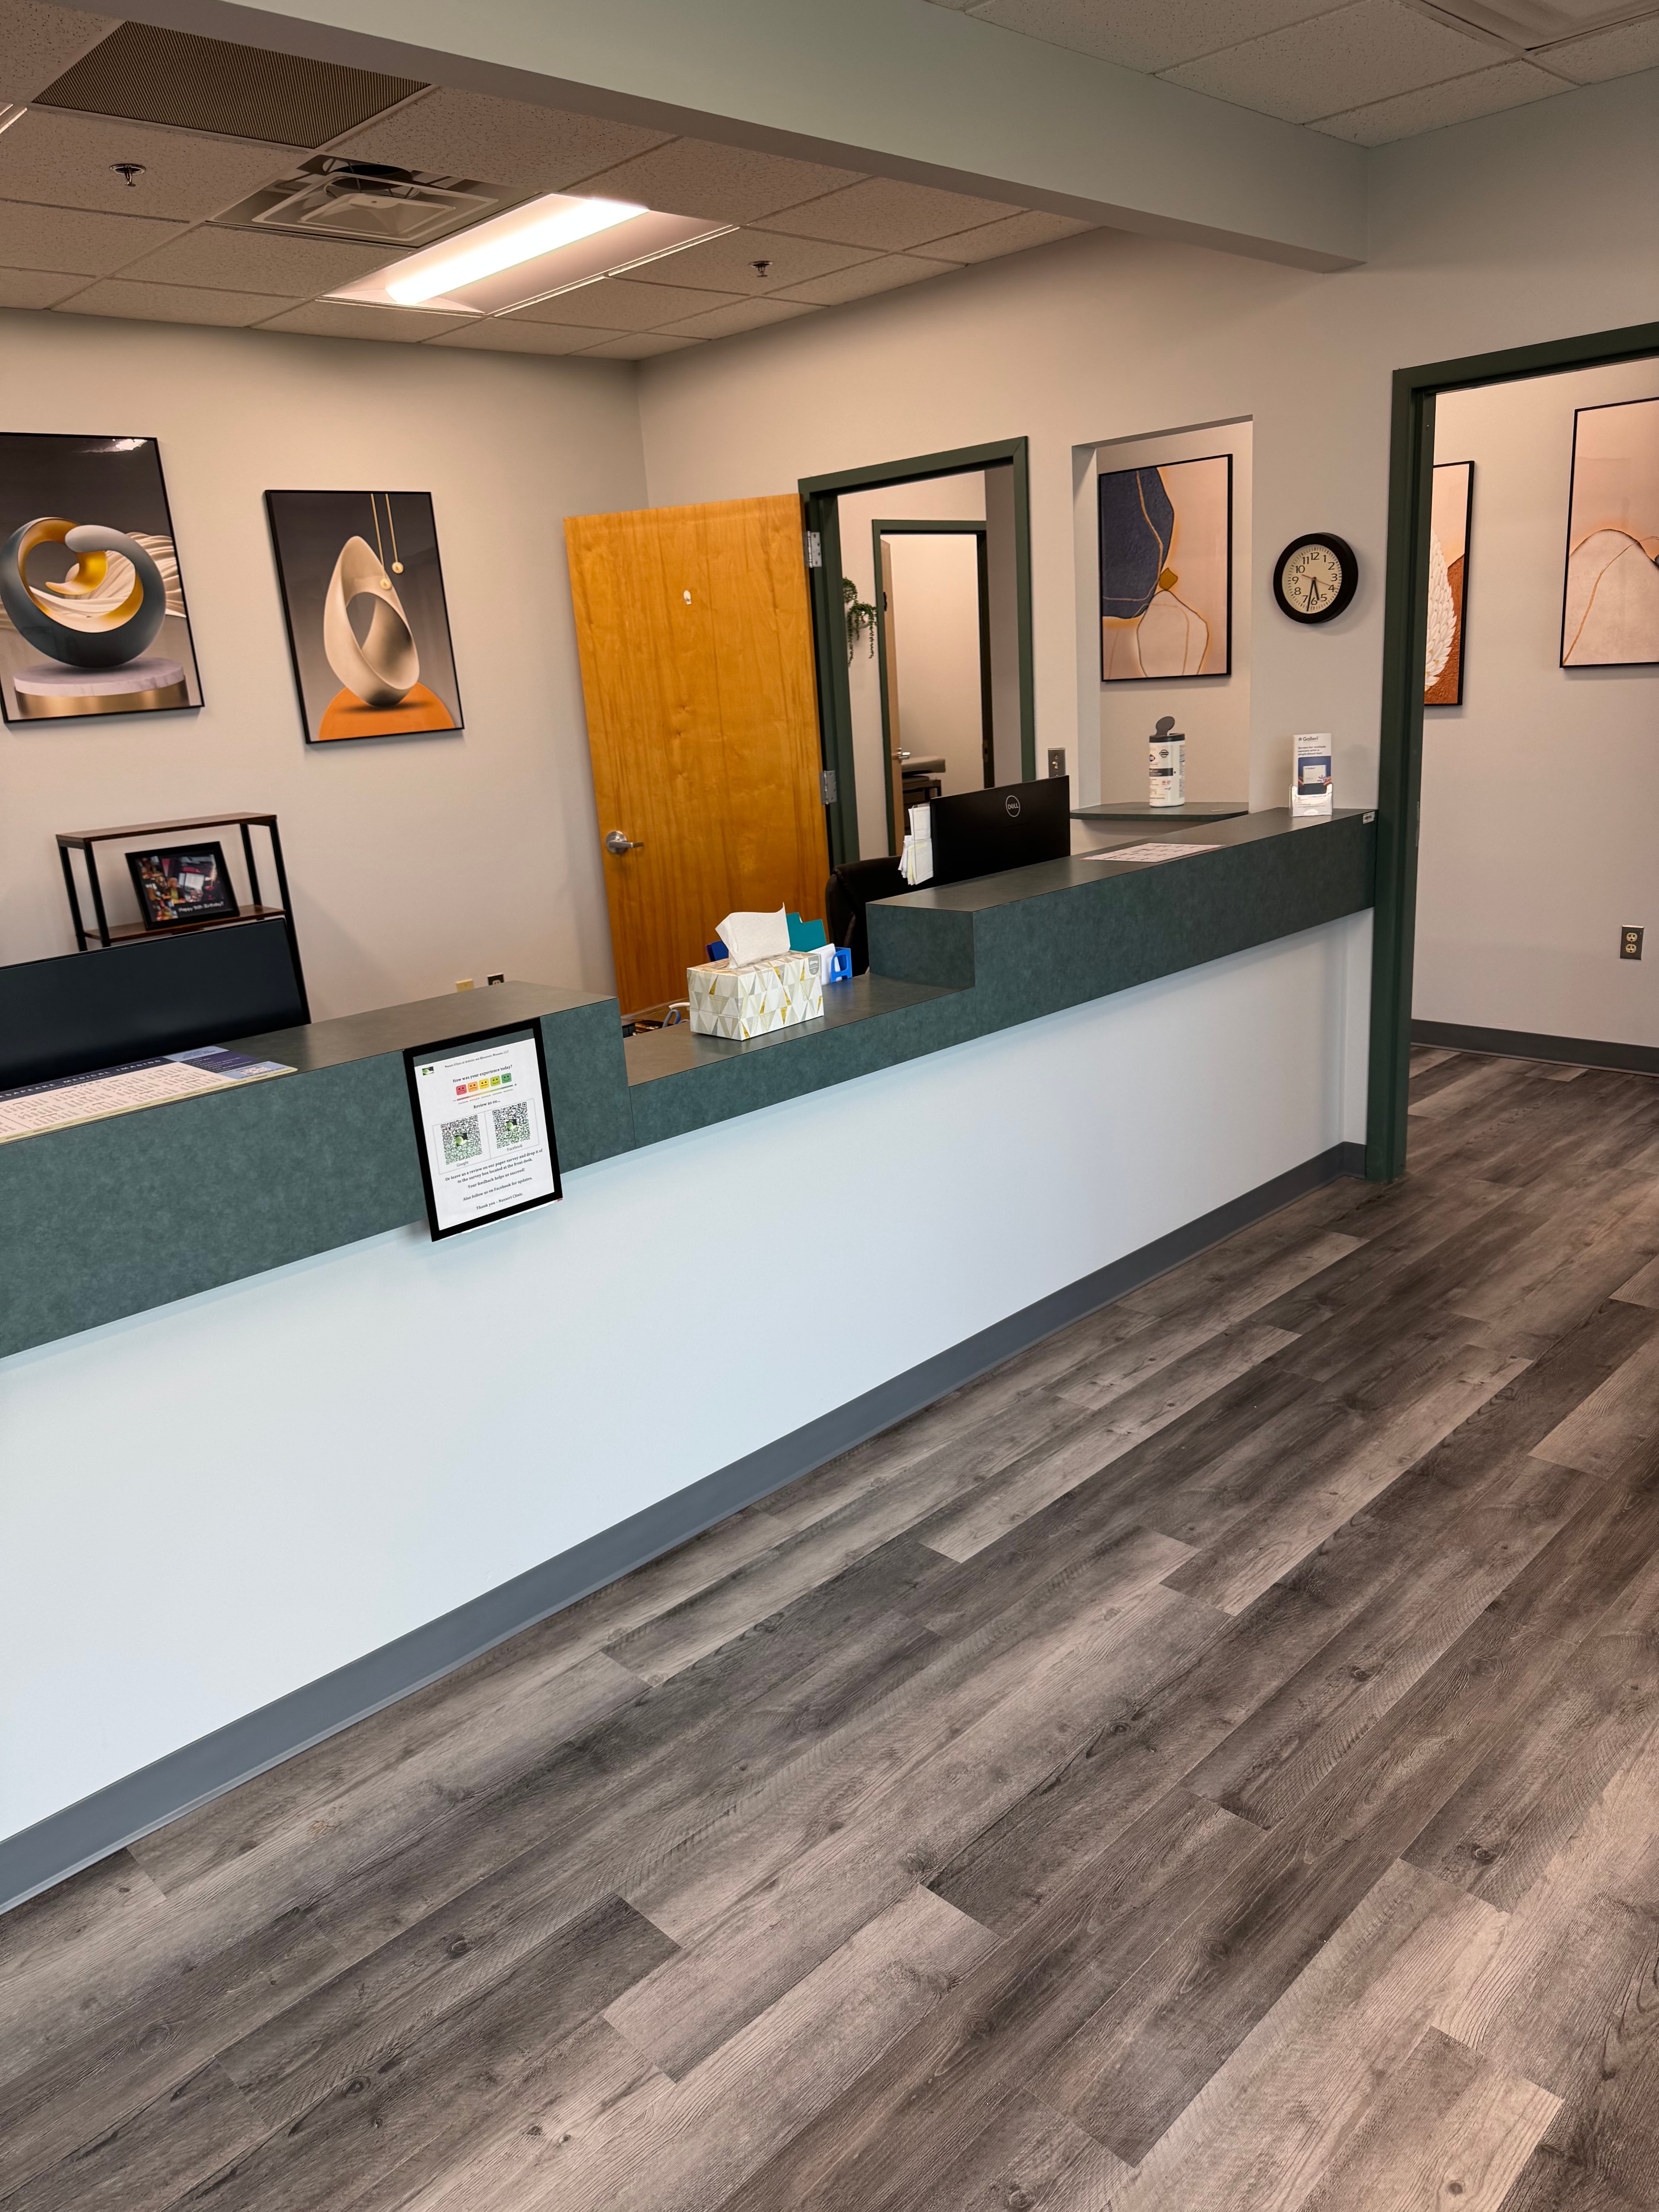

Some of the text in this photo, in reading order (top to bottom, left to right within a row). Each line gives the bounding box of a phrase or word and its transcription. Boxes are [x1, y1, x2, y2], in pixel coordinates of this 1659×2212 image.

[1310, 552, 1319, 560] 12
[1302, 556, 1309, 565] 11
[1295, 565, 1305, 573] 10
[1331, 573, 1338, 582] 3
[1294, 587, 1301, 595] 8
[1302, 595, 1308, 603] 7
[1311, 597, 1318, 605] 6
[1320, 593, 1328, 602] 5
[63, 1071, 111, 1083] MEDICAL
[115, 1059, 161, 1071] IMAGING
[477, 1177, 494, 1185] feedback
[494, 1183, 511, 1191] Facebook
